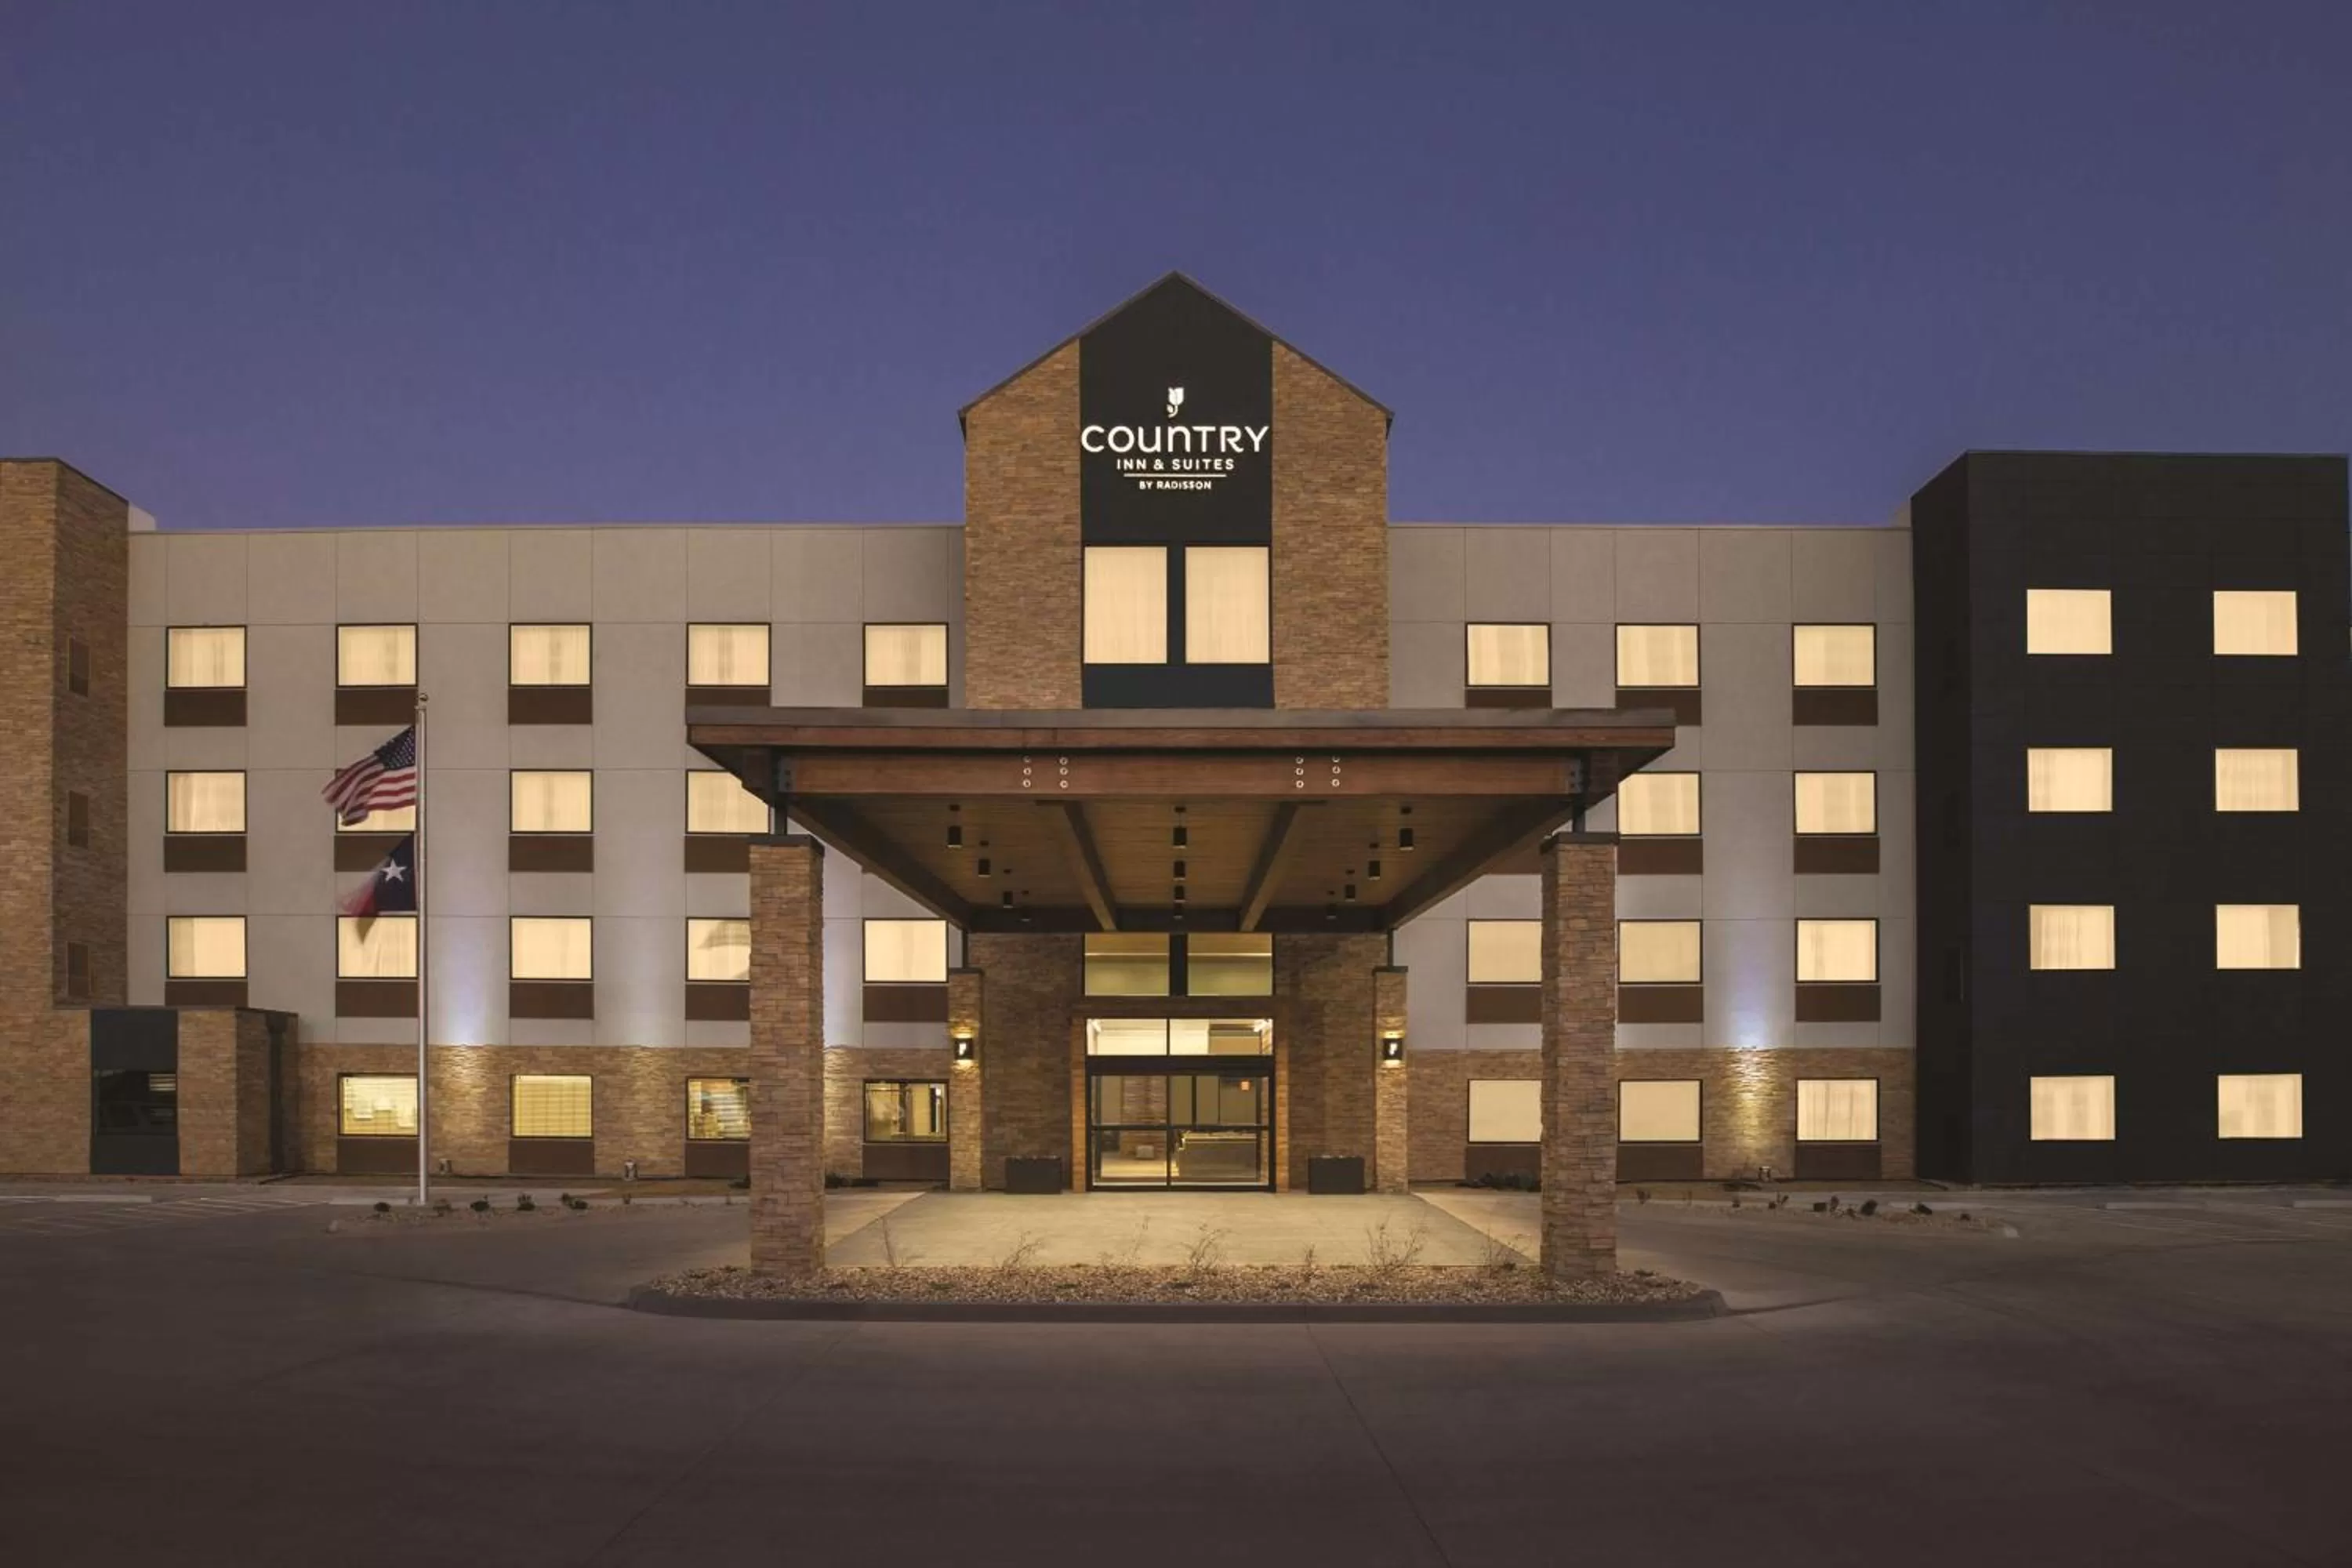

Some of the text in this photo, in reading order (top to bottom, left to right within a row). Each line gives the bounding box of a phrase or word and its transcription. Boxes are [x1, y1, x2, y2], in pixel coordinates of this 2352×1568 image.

[1116, 459, 1235, 470] INN & SUITES
[1139, 481, 1212, 490] BY RADISSON
